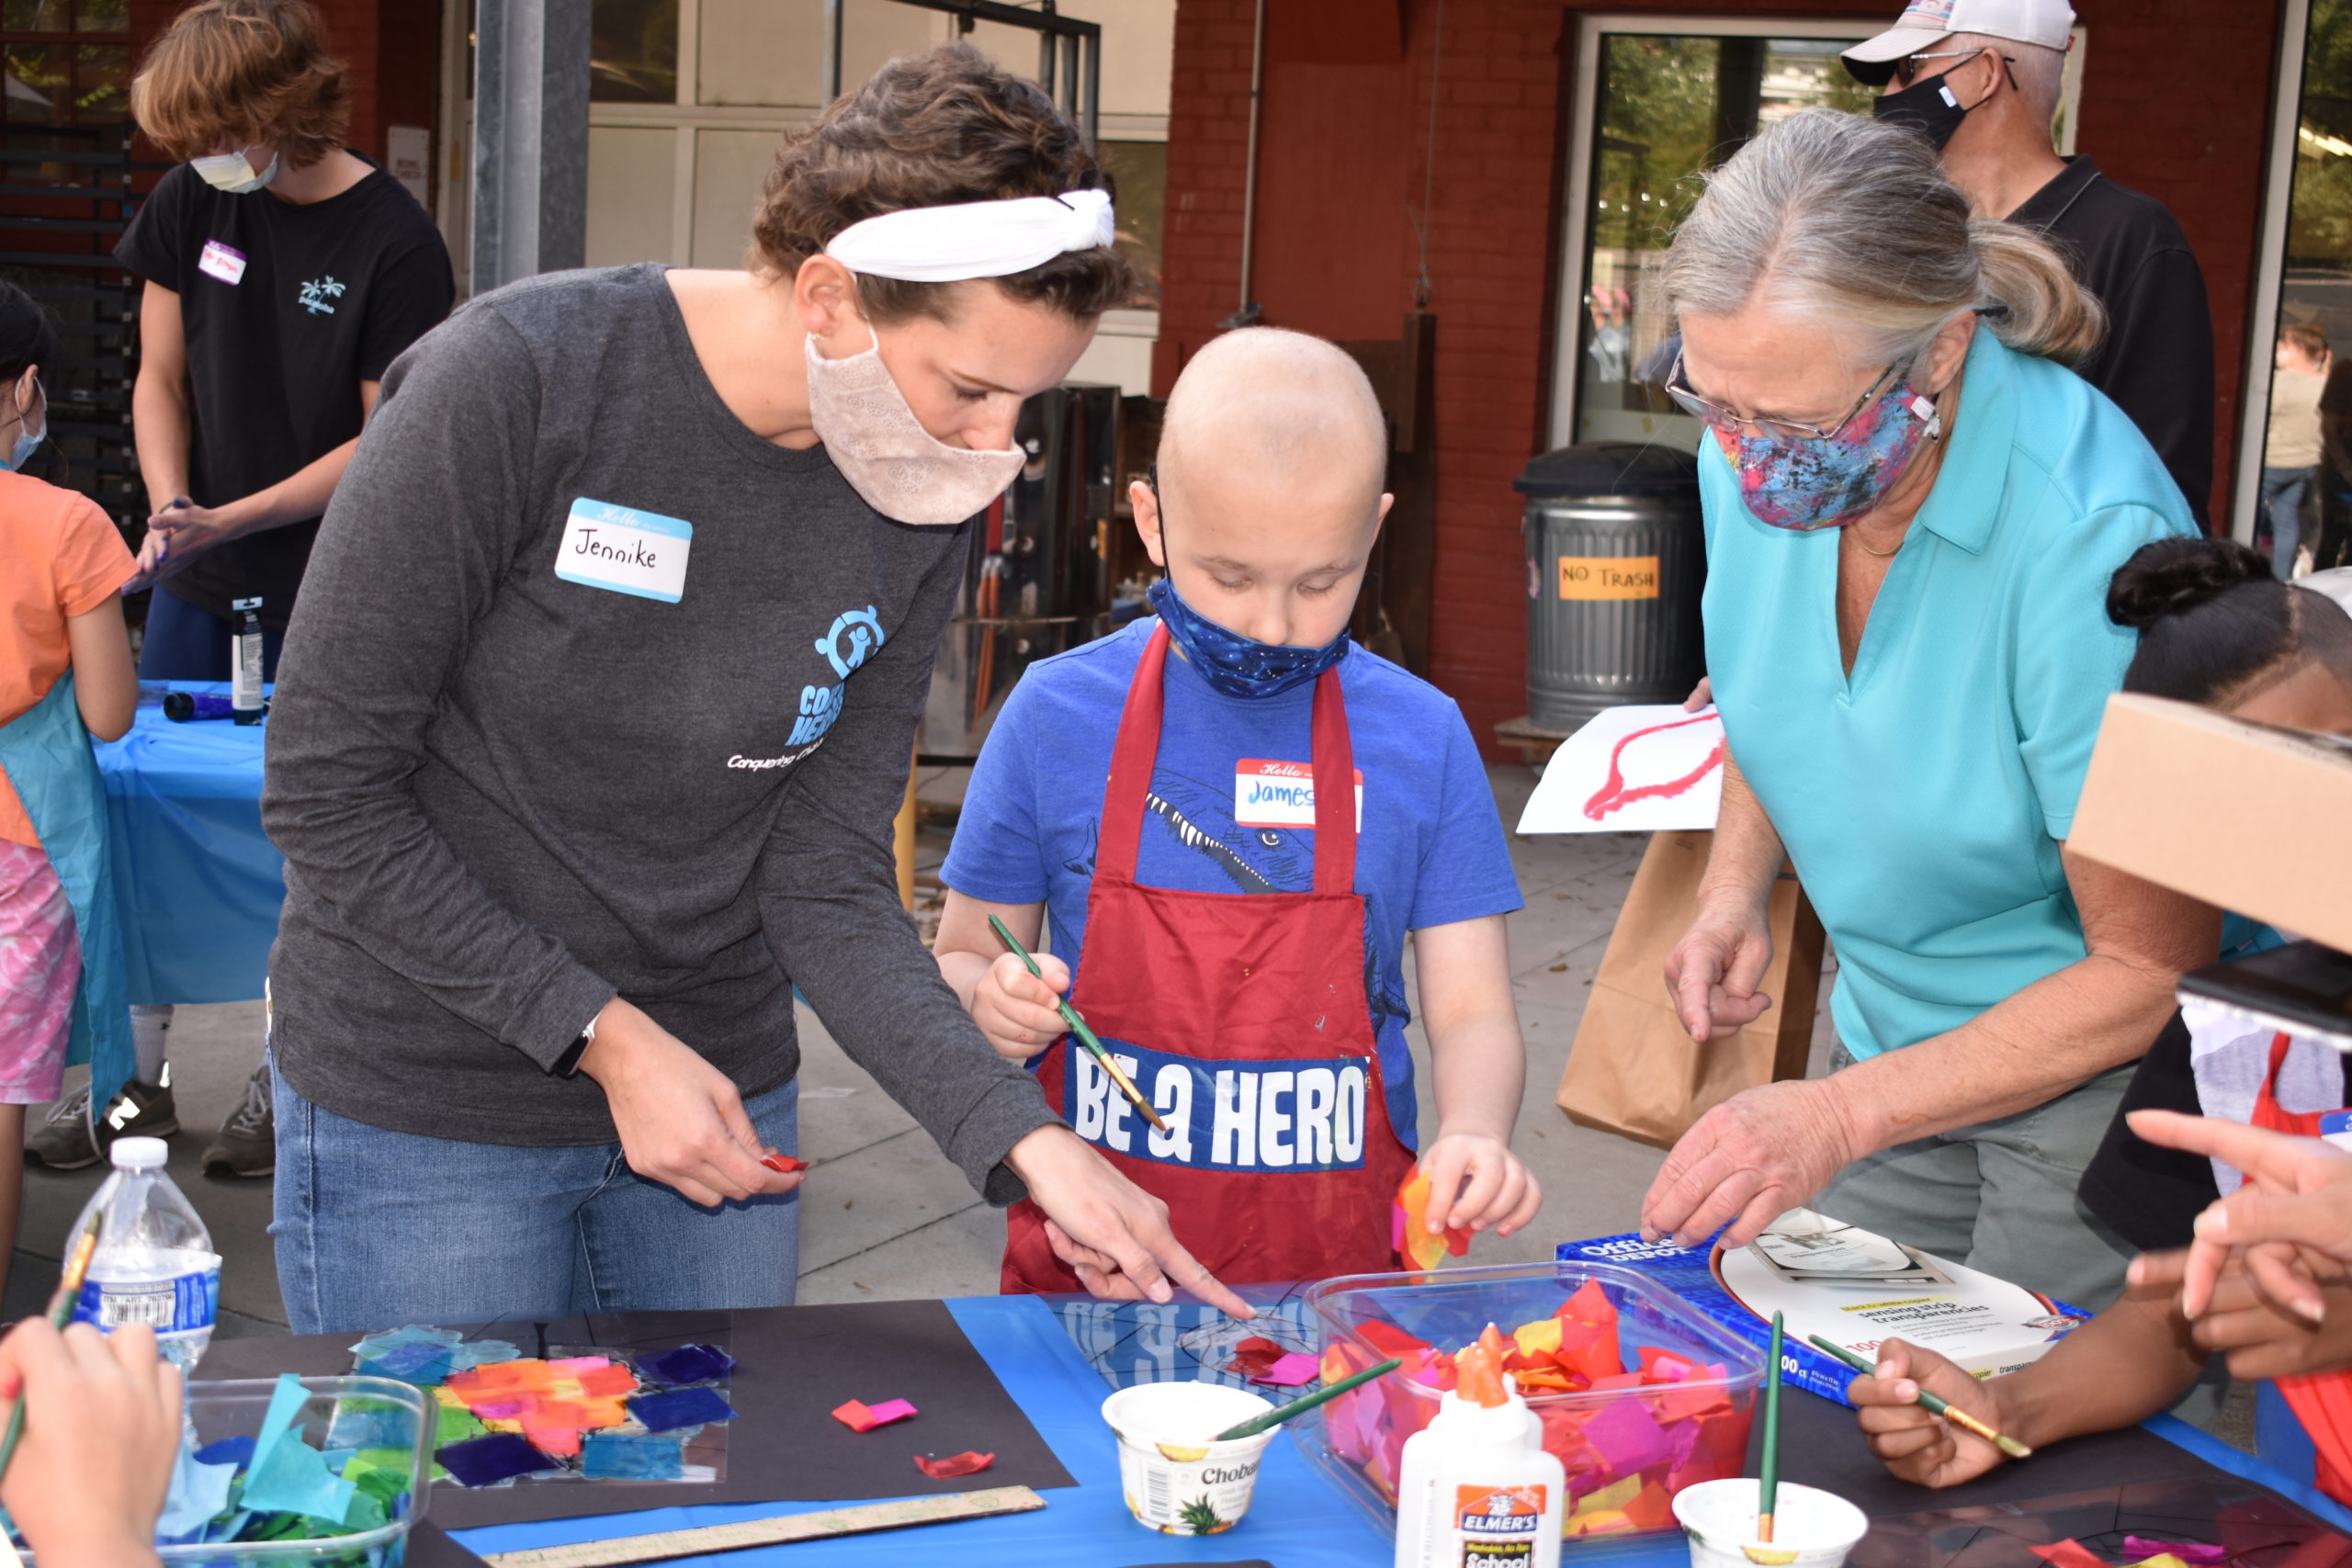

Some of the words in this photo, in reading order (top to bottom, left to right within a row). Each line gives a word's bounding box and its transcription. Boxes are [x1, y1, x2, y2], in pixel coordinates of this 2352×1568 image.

[597, 506, 640, 527] Hello
[575, 528, 657, 569] Jennike
[1563, 565, 1589, 581] NO
[1259, 762, 1304, 777] Hello
[1248, 780, 1316, 807] James
[1075, 1045, 1138, 1153] BE
[1148, 1063, 1193, 1163] a
[1210, 1066, 1365, 1167] HERO
[1606, 1247, 1691, 1262] DEPOT
[1859, 1303, 1919, 1318] sensing
[1917, 1301, 1957, 1314] strip
[1871, 1304, 1990, 1324] transparencies
[1781, 1355, 1798, 1374] 00
[1464, 1515, 1536, 1531] ELMER'S
[1465, 1552, 1532, 1568] School
